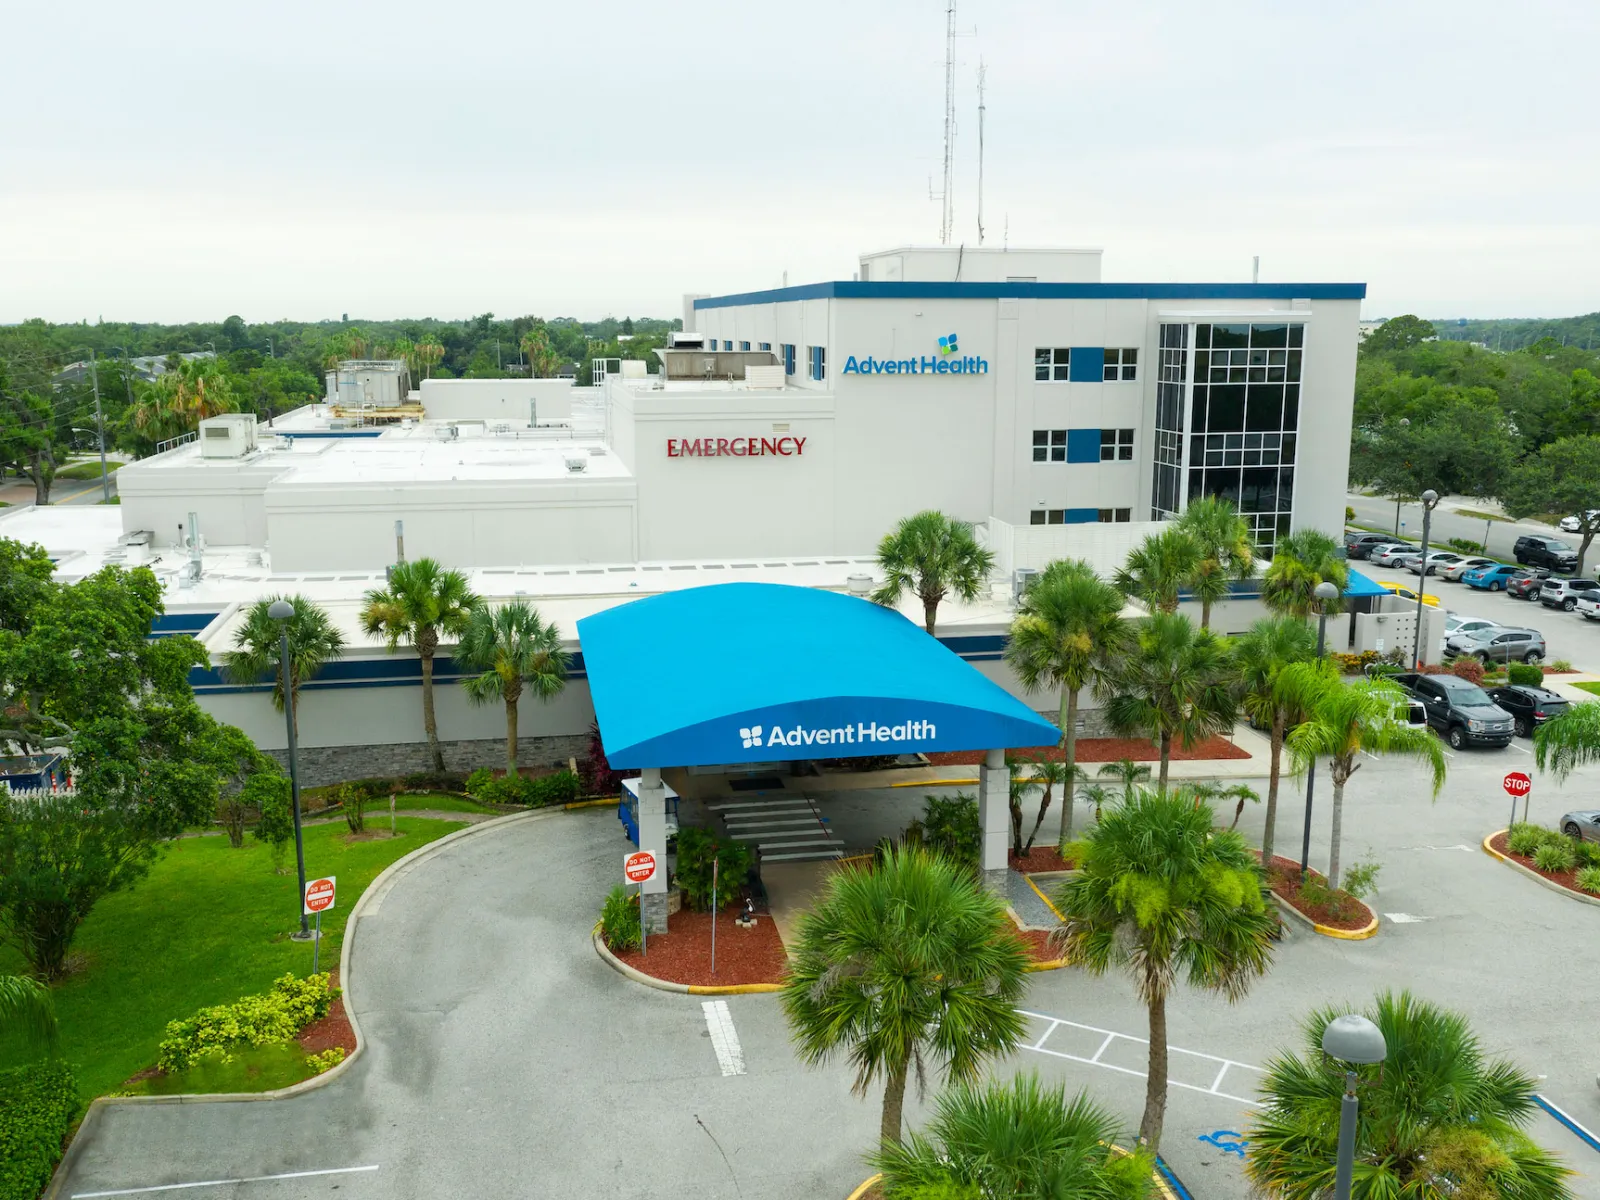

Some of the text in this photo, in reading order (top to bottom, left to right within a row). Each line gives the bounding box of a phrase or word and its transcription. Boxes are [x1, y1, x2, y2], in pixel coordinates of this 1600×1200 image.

[666, 437, 807, 458] EMERGENCY
[1504, 777, 1531, 791] STOP
[629, 856, 652, 866] DO NOT
[631, 869, 650, 878] ENTER
